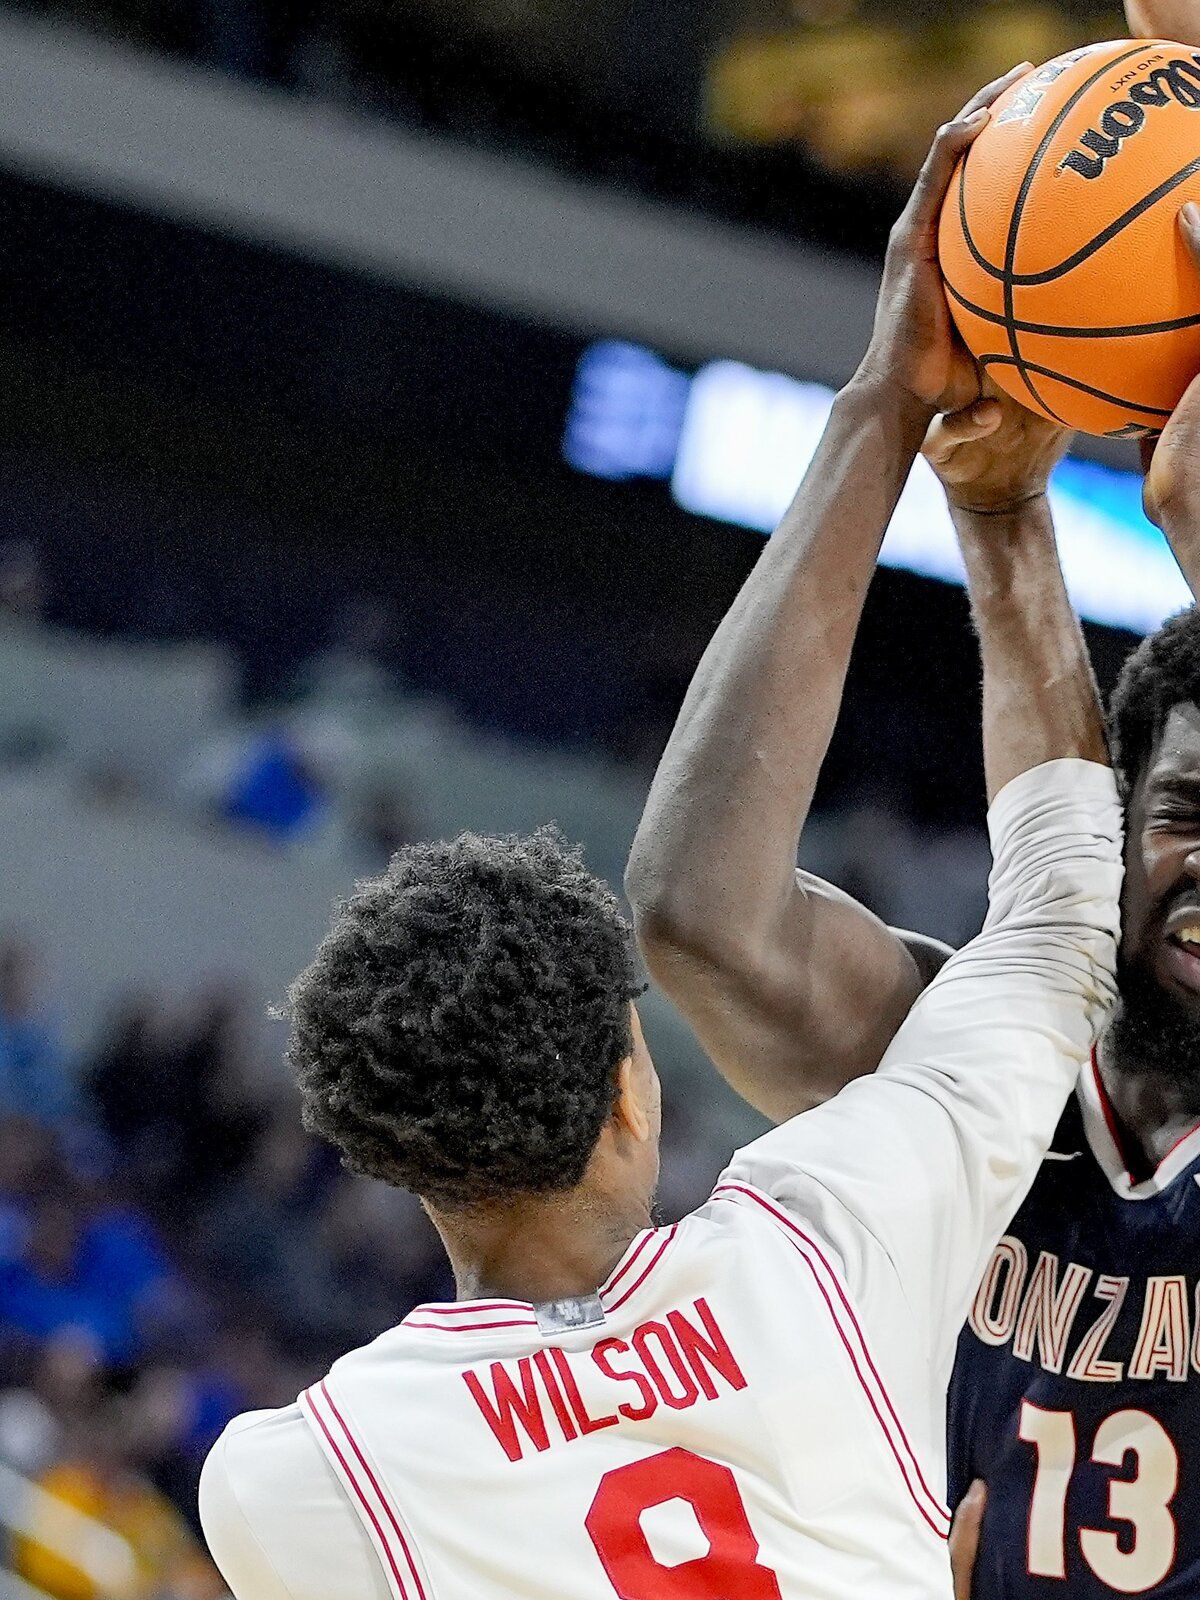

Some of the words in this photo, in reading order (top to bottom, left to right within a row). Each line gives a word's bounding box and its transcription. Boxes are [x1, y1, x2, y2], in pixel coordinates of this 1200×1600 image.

[1109, 71, 1137, 94] NXT
[1137, 54, 1164, 71] EVO
[461, 1297, 748, 1462] WILSON
[1017, 1397, 1179, 1593] 13
